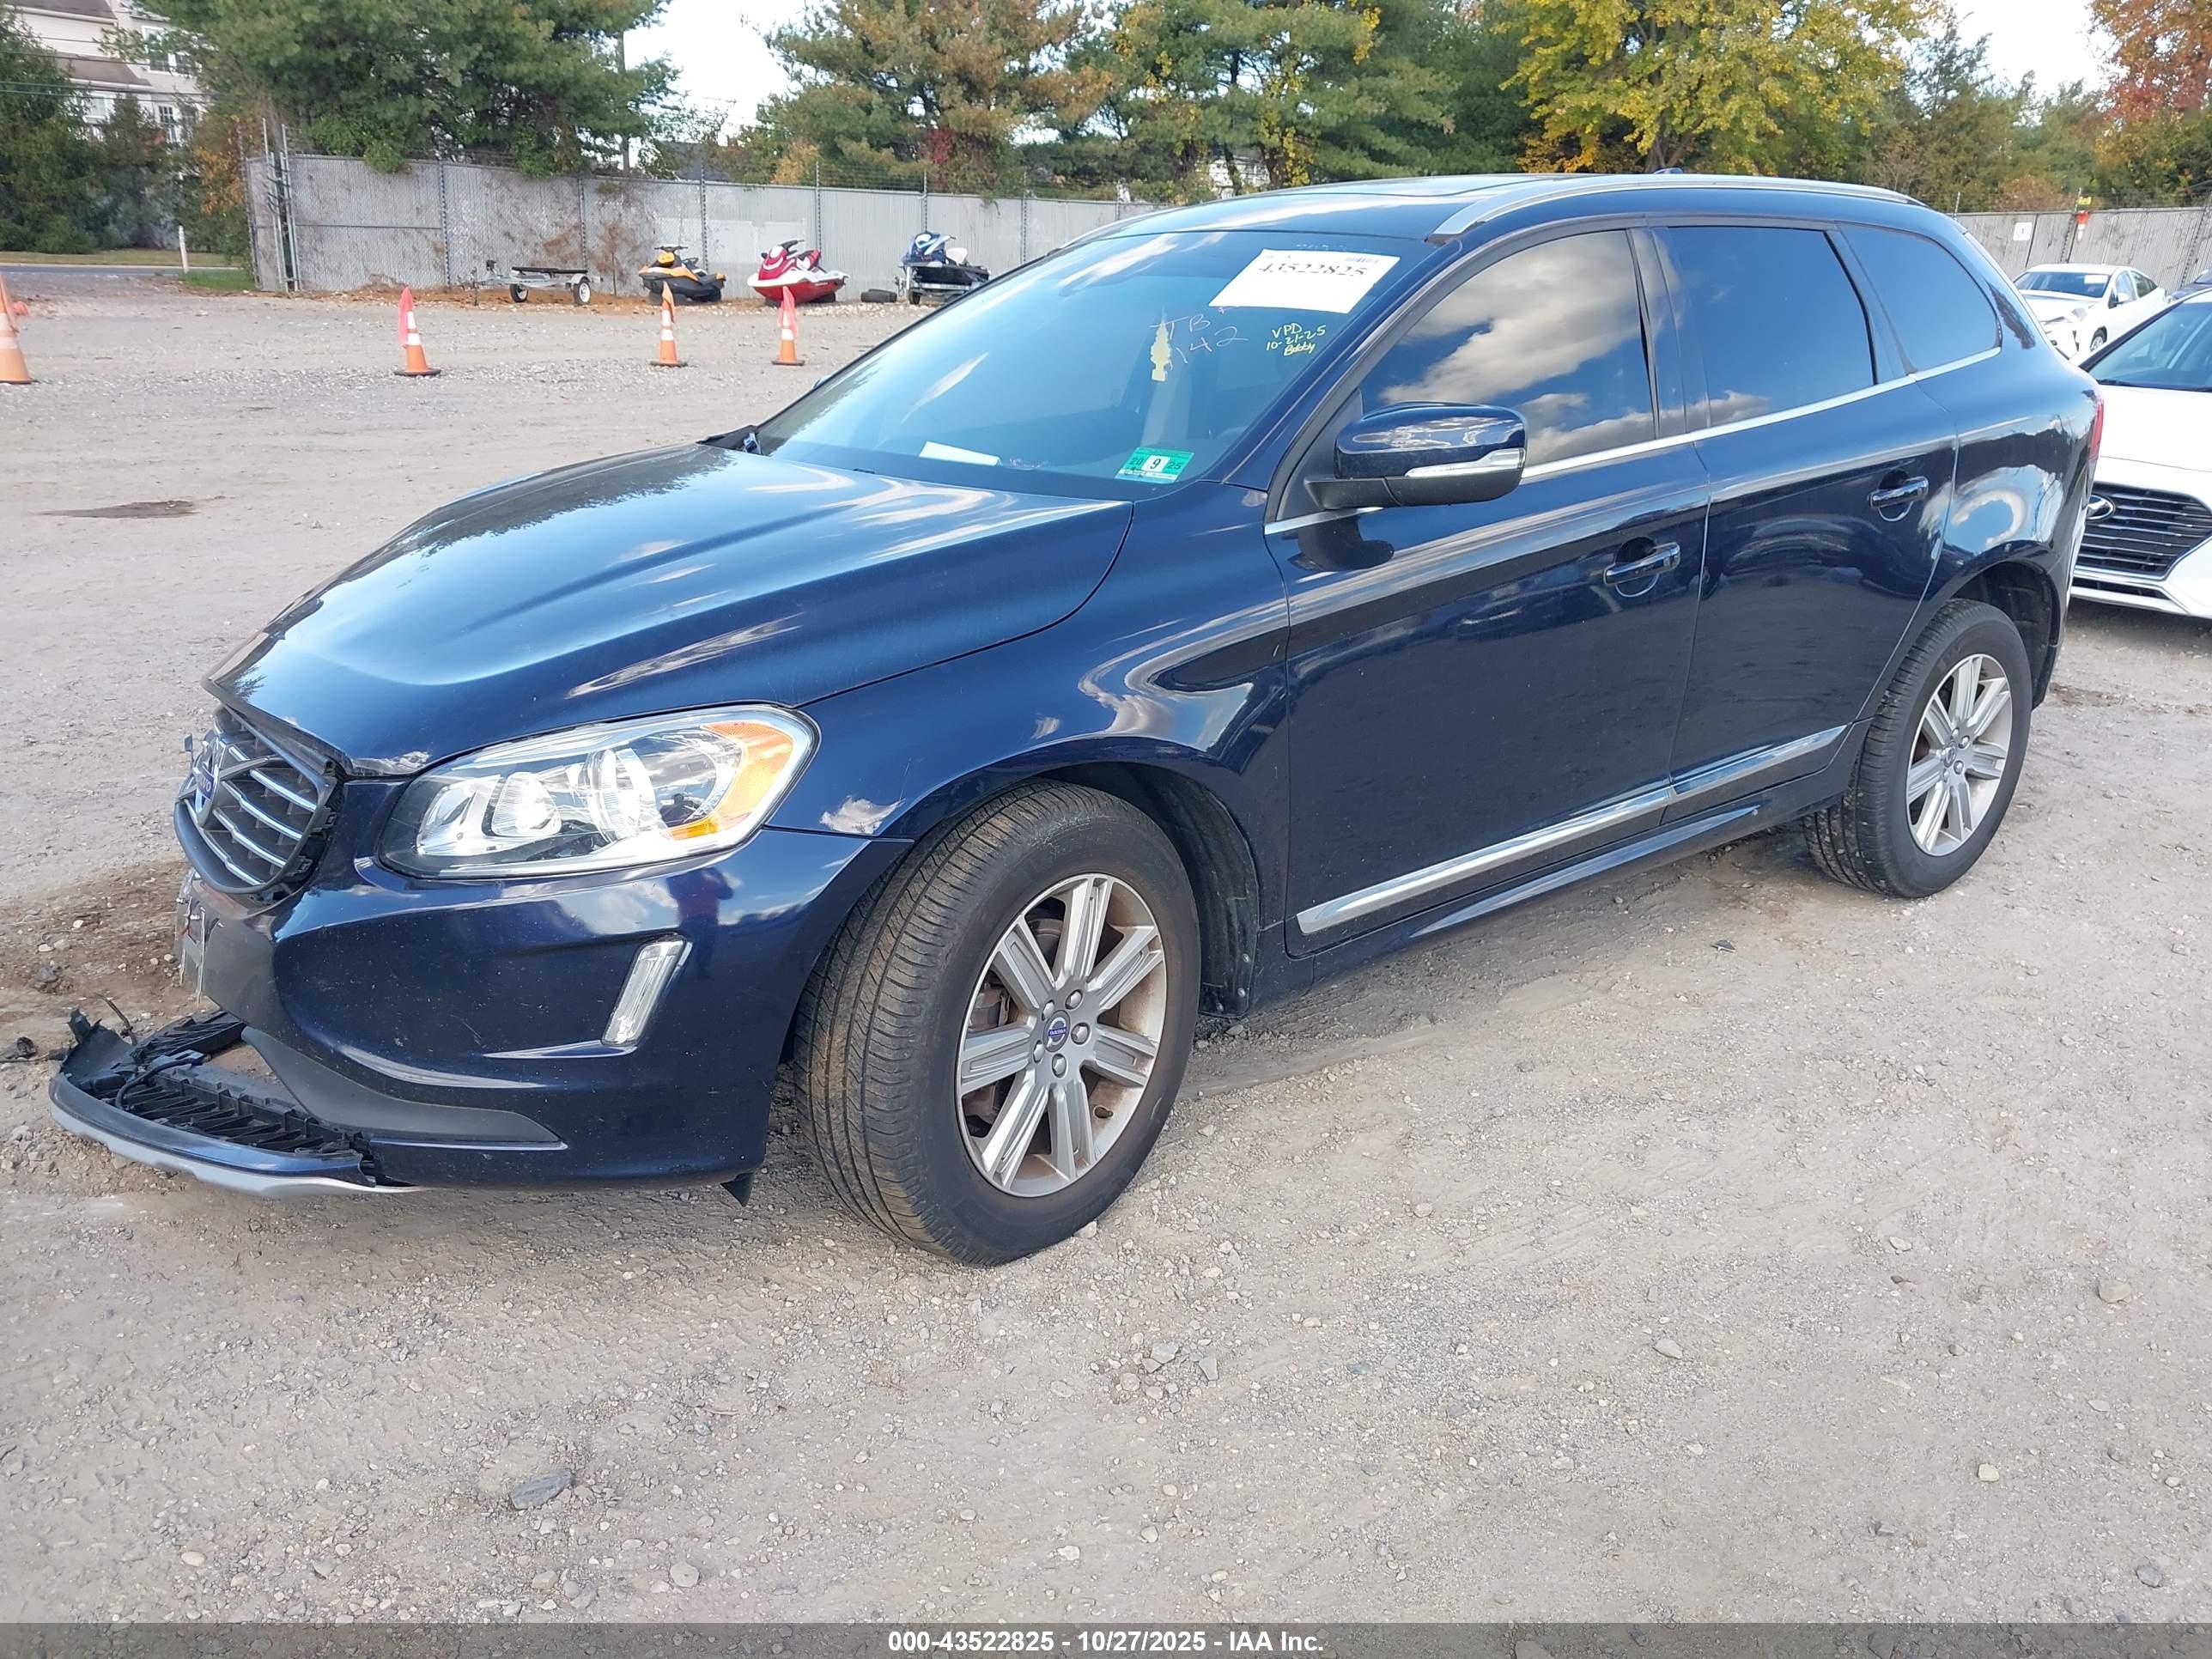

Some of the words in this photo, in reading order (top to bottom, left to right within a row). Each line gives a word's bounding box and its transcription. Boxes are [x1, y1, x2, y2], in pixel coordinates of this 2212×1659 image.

[1271, 322, 1303, 339] VPD
[1129, 457, 1144, 465] 20
[1149, 458, 1162, 470] 9
[1166, 461, 1182, 470] 25
